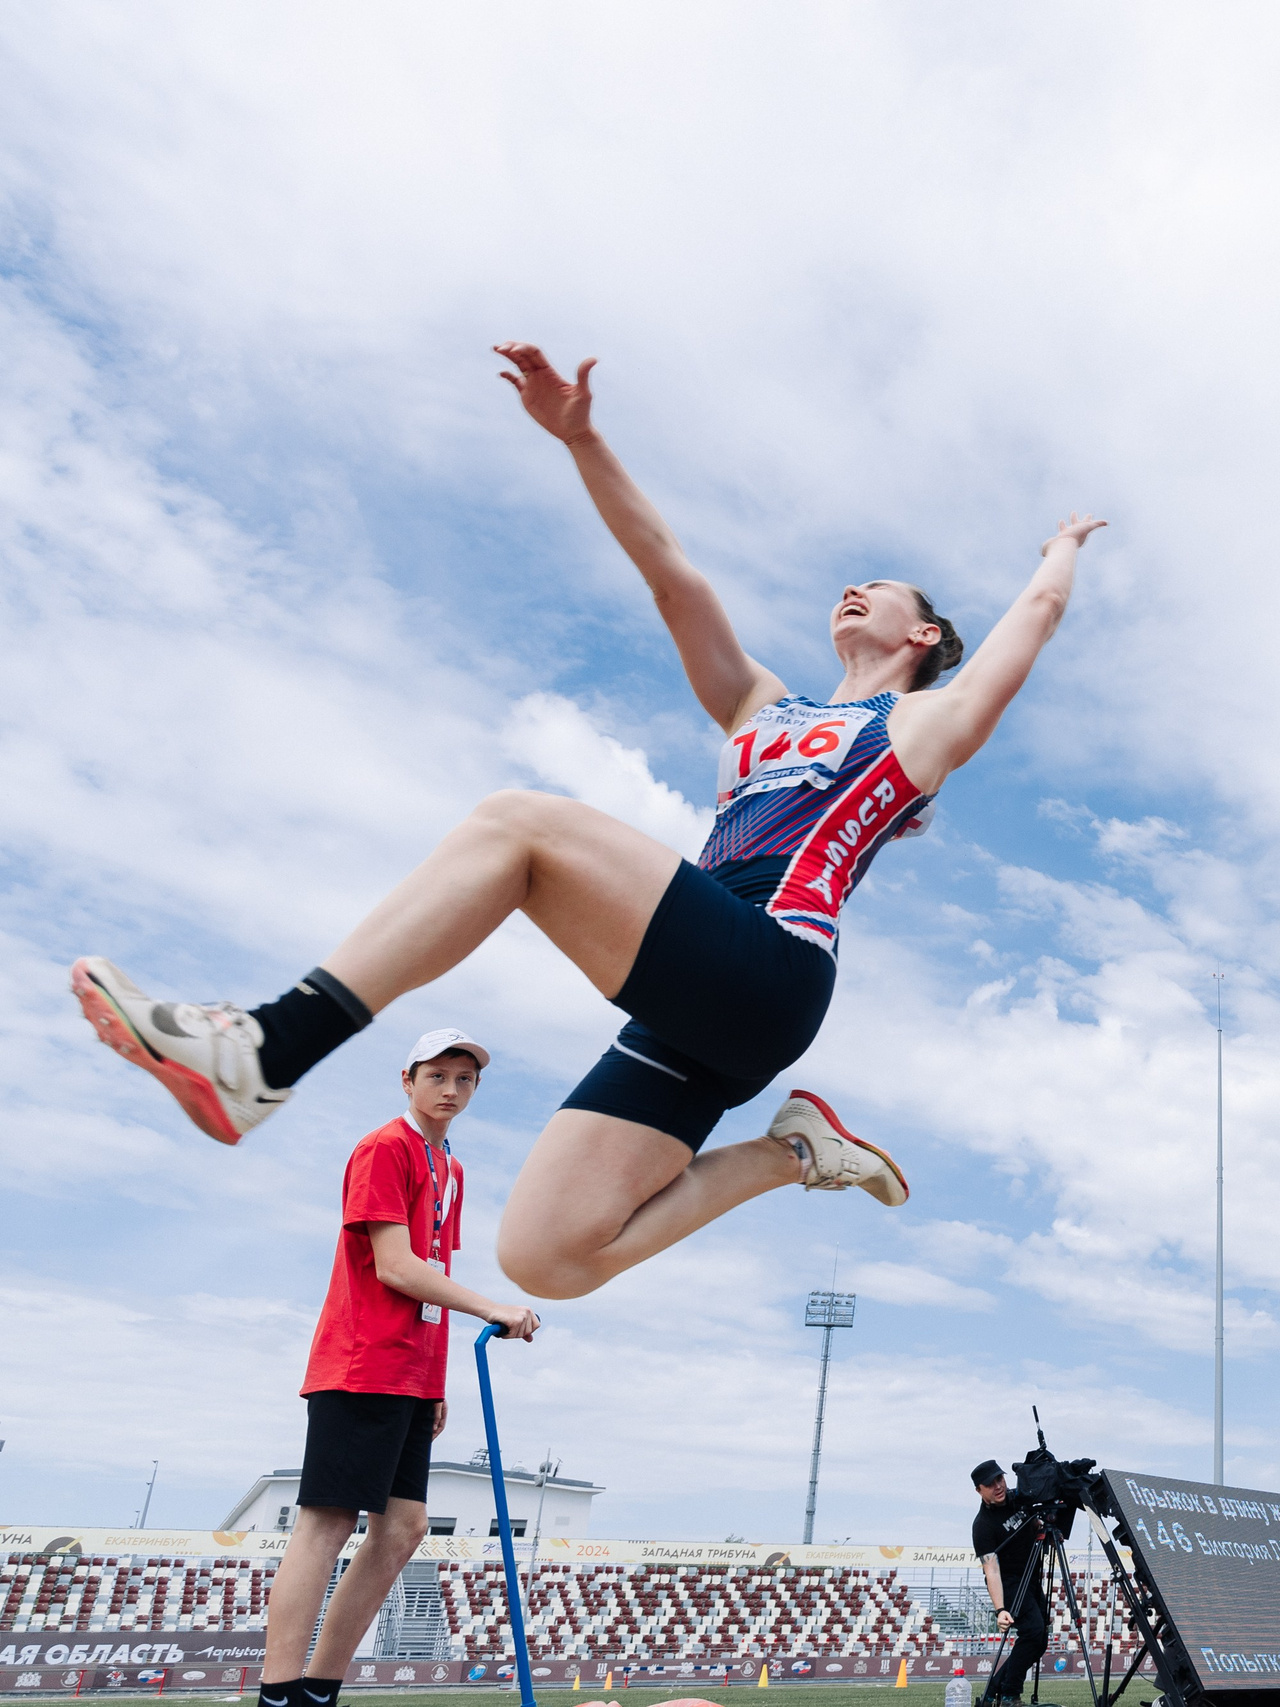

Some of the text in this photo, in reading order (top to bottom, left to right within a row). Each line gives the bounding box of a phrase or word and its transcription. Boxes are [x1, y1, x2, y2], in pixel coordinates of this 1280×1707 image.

[733, 720, 846, 778] 146
[806, 777, 897, 904] RUSSIA
[1124, 1478, 1207, 1514] Прыжок
[1218, 1497, 1270, 1526] длину
[104, 1537, 192, 1547] ЕКАТЕРИНБУРГ
[1135, 1518, 1193, 1553] 146
[577, 1545, 610, 1557] 2024
[641, 1547, 756, 1559] ЗАПАДНАЯ ТРИБУНА
[805, 1551, 866, 1560] ЕКАТЕРИНБУРГ
[913, 1552, 965, 1562] ЗАПАДНАЯ
[1194, 1532, 1272, 1565] Виктория
[45, 1643, 184, 1665] ОБЛАСТЬ
